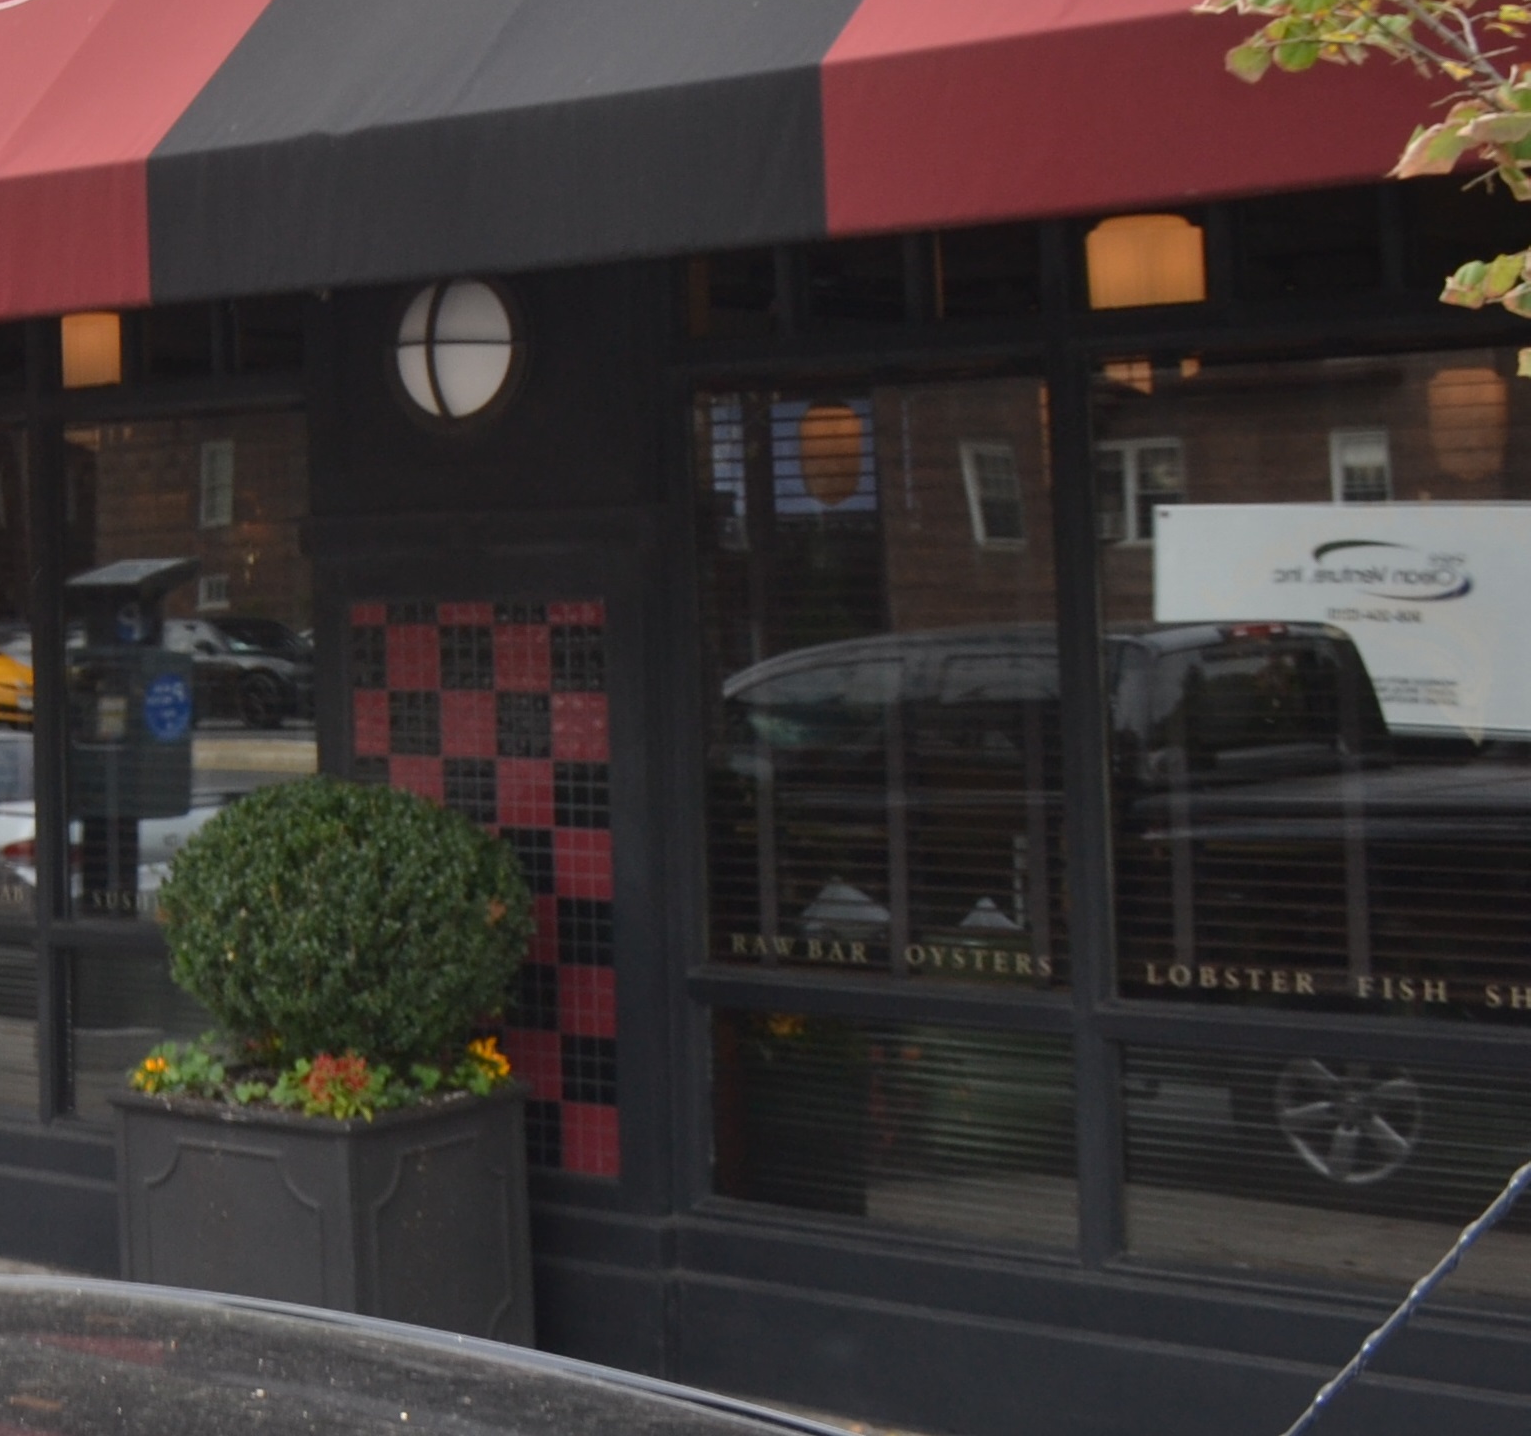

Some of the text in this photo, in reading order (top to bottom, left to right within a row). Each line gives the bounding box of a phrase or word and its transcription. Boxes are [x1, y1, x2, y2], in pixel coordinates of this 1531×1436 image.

[731, 932, 1053, 978] RAW BAR OYSTERS
[1146, 964, 1316, 996] LOBSTER
[1356, 975, 1448, 1004] FISH
